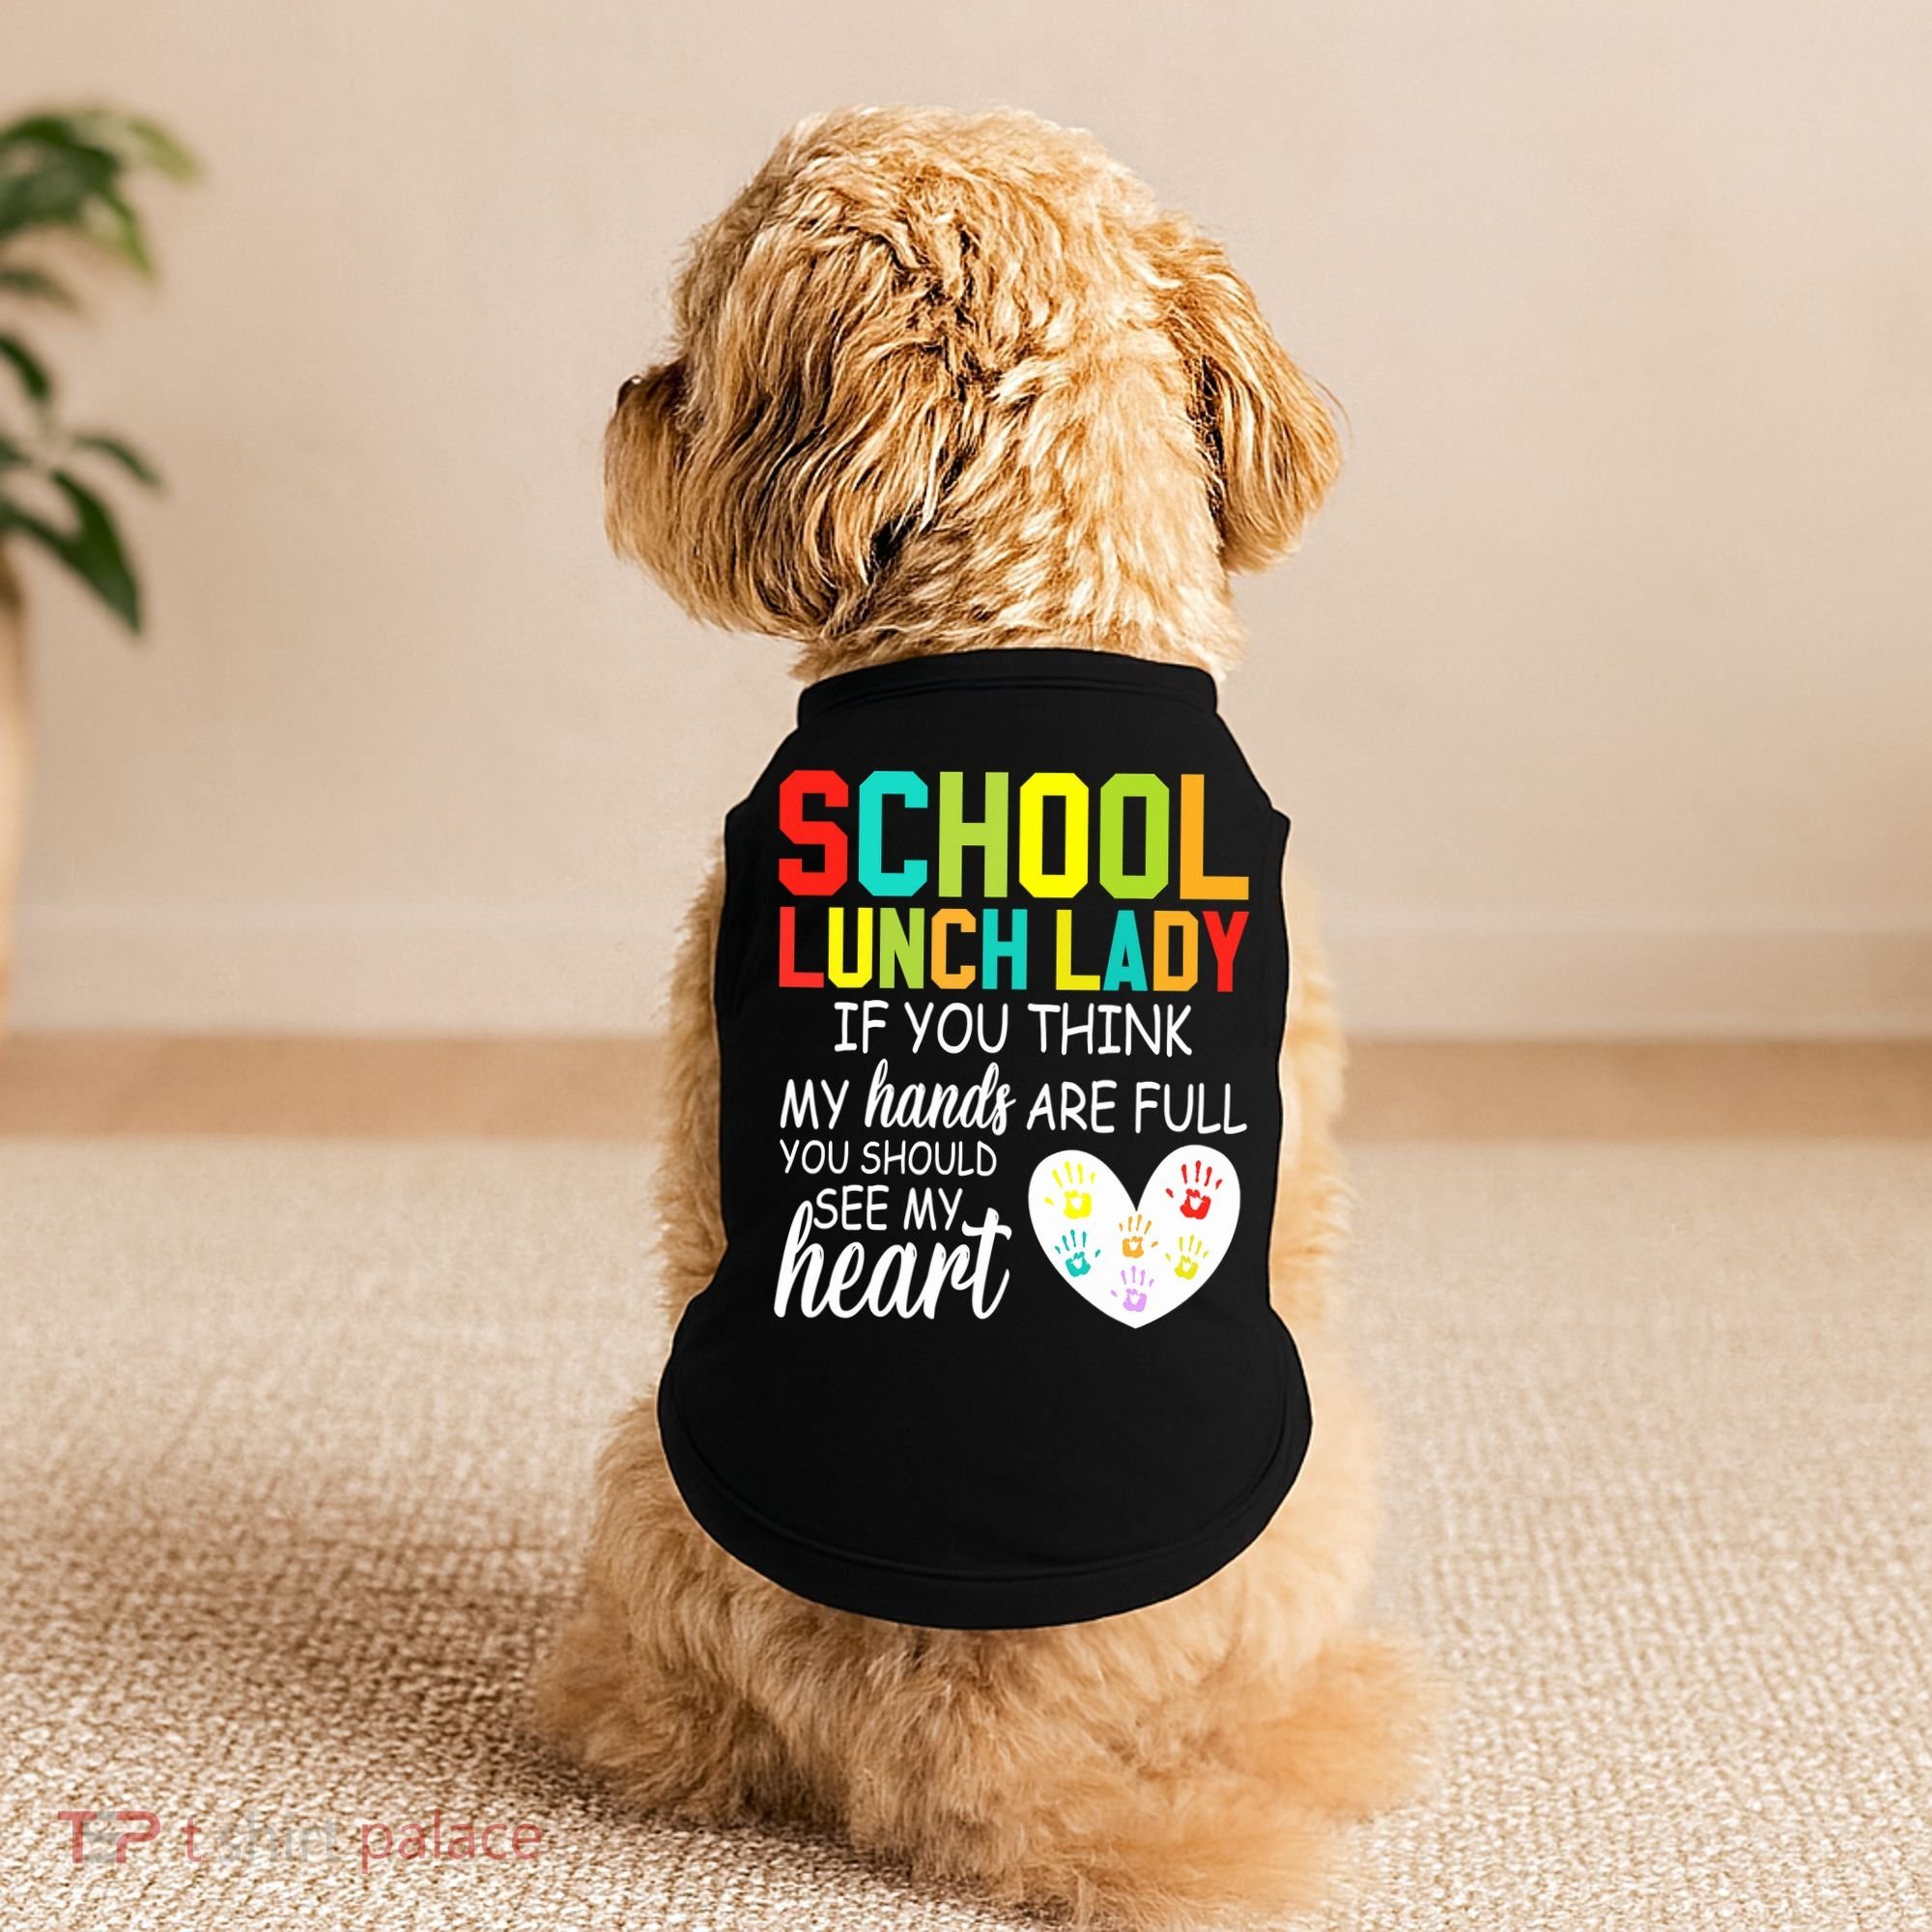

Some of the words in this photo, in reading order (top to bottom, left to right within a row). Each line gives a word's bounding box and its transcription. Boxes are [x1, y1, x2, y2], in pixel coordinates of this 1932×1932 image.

[779, 770, 1250, 900] SCHOOL
[779, 907, 1028, 990] LUNCH
[1056, 909, 1250, 992] LADY
[834, 1000, 889, 1054] IF
[904, 1002, 1009, 1054] YOU
[1027, 1003, 1193, 1058] THINK
[780, 1078, 850, 1130] MY
[864, 1059, 1017, 1136] hands
[1026, 1079, 1118, 1133] ARE
[1134, 1081, 1248, 1135] FULL
[779, 1138, 849, 1175] YOU
[860, 1139, 998, 1177] SHOULD
[812, 1184, 890, 1231] SEE
[903, 1186, 963, 1232] MY
[773, 1200, 1012, 1321] heart
